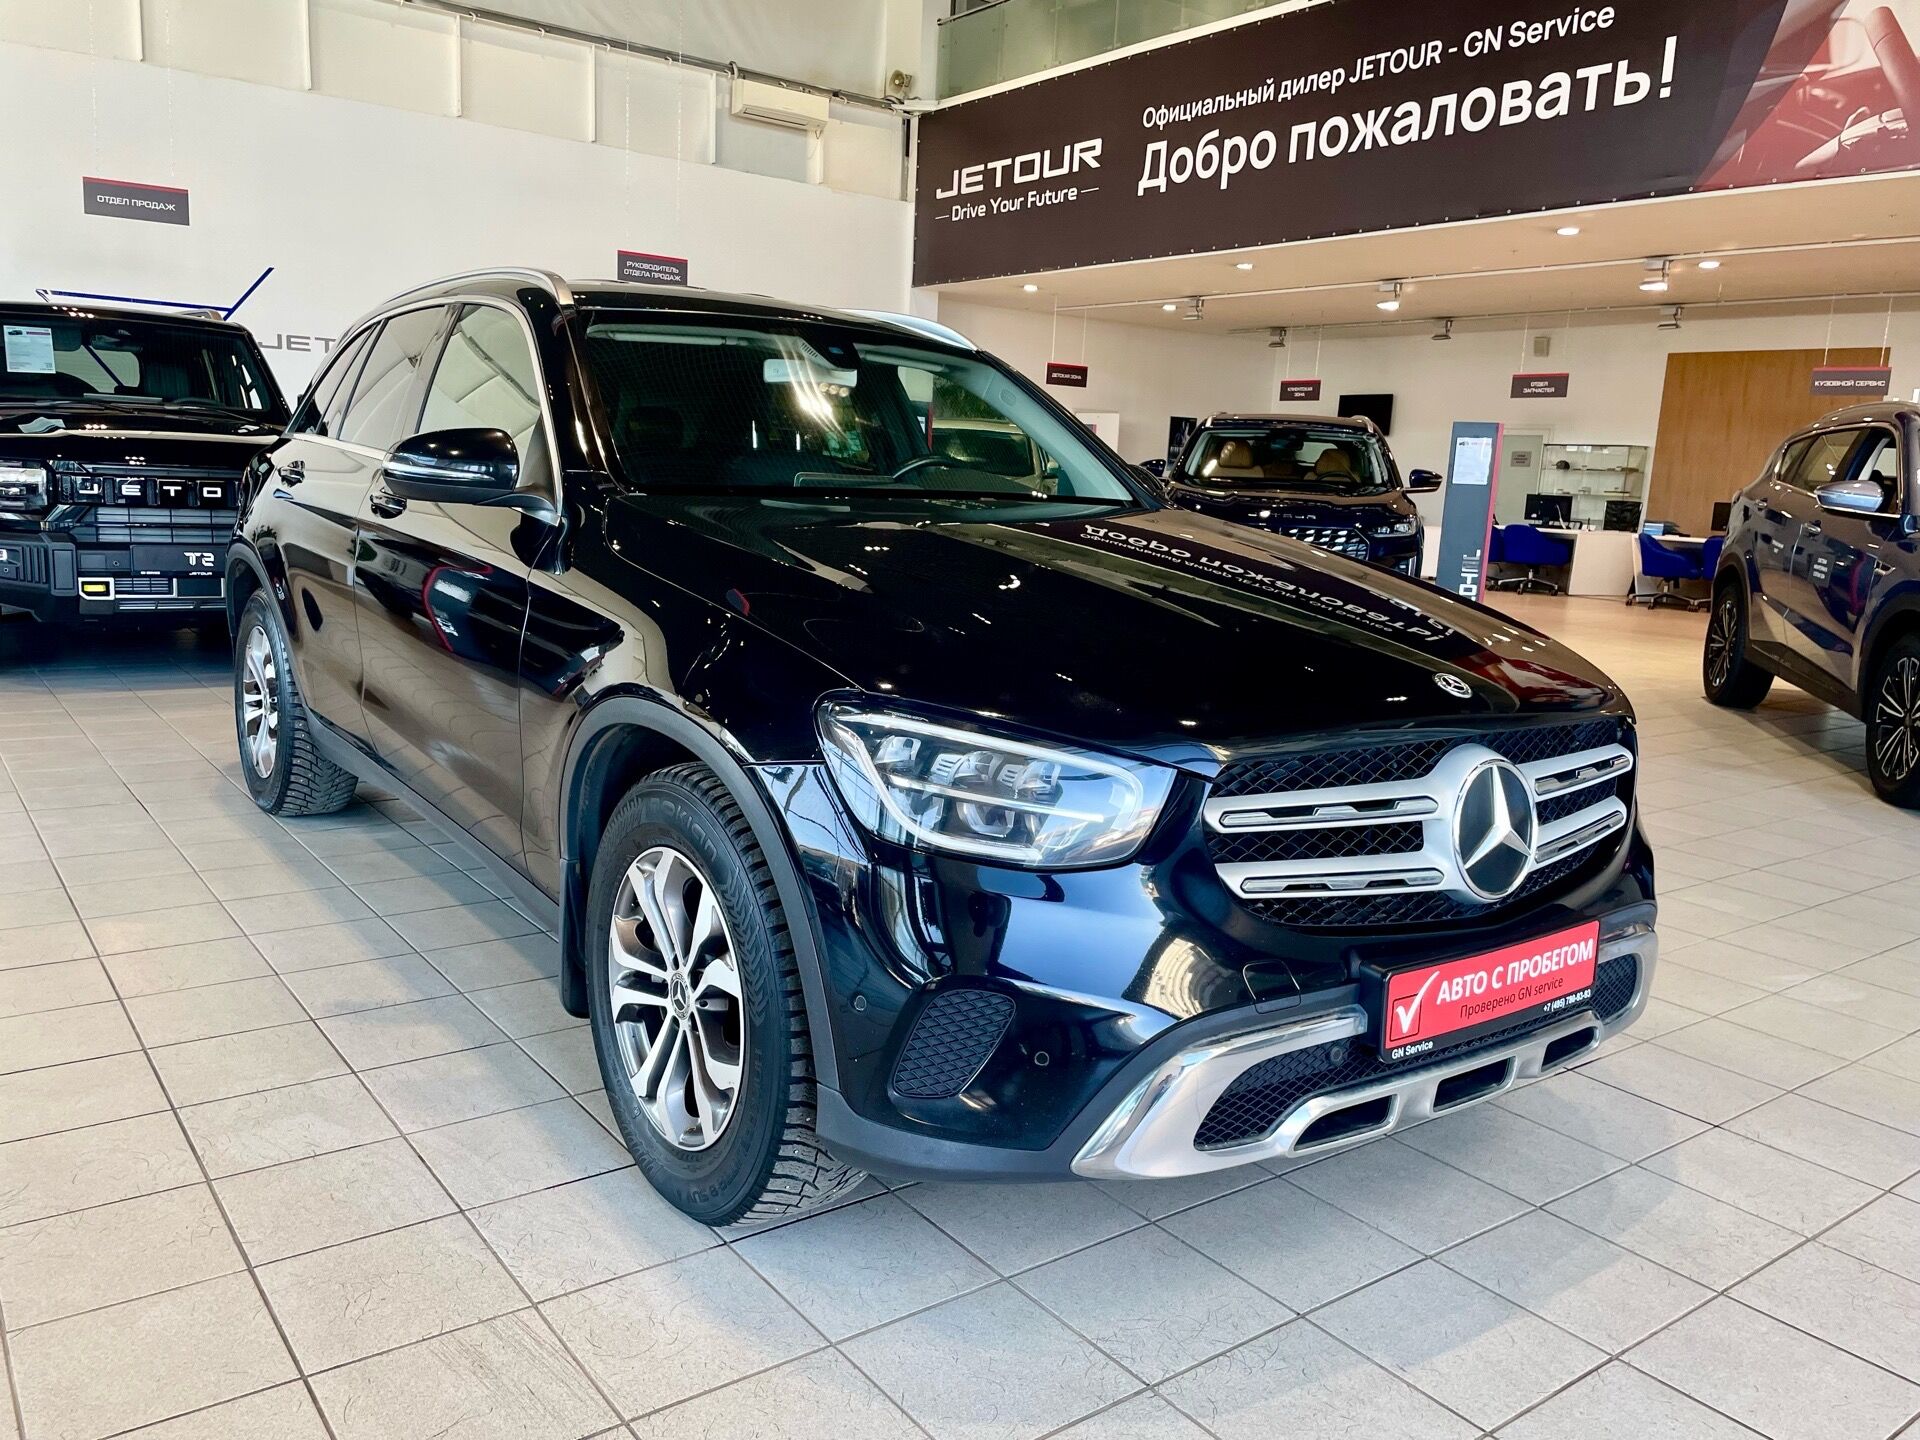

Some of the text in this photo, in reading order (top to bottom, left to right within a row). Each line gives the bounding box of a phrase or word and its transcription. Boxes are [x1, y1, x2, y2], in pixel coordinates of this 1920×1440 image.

[1142, 78, 1275, 130] Официальный
[1278, 66, 1345, 102] дилер
[1349, 39, 1442, 83] JETOUR
[1463, 26, 1503, 57] GN
[1508, 6, 1616, 48] Service
[1136, 35, 1678, 197] Добро пожаловать!
[935, 137, 1103, 200] JETOUR
[96, 194, 176, 212] ОТДЕЛ ПРОДАЖ
[951, 186, 1079, 222] Drive Your Future
[623, 268, 682, 282] ОТДЕЛА ПРОДАЖ
[626, 260, 680, 274] РУКОВОДИТЕЛЬ
[1814, 379, 1855, 387] КУЗОВНОЙ
[183, 551, 216, 567] T2
[1436, 938, 1594, 1005] АВТО С ПРОБЕГОМ
[1460, 977, 1564, 1020] Проверено GN service
[1391, 1040, 1434, 1061] GN Service
